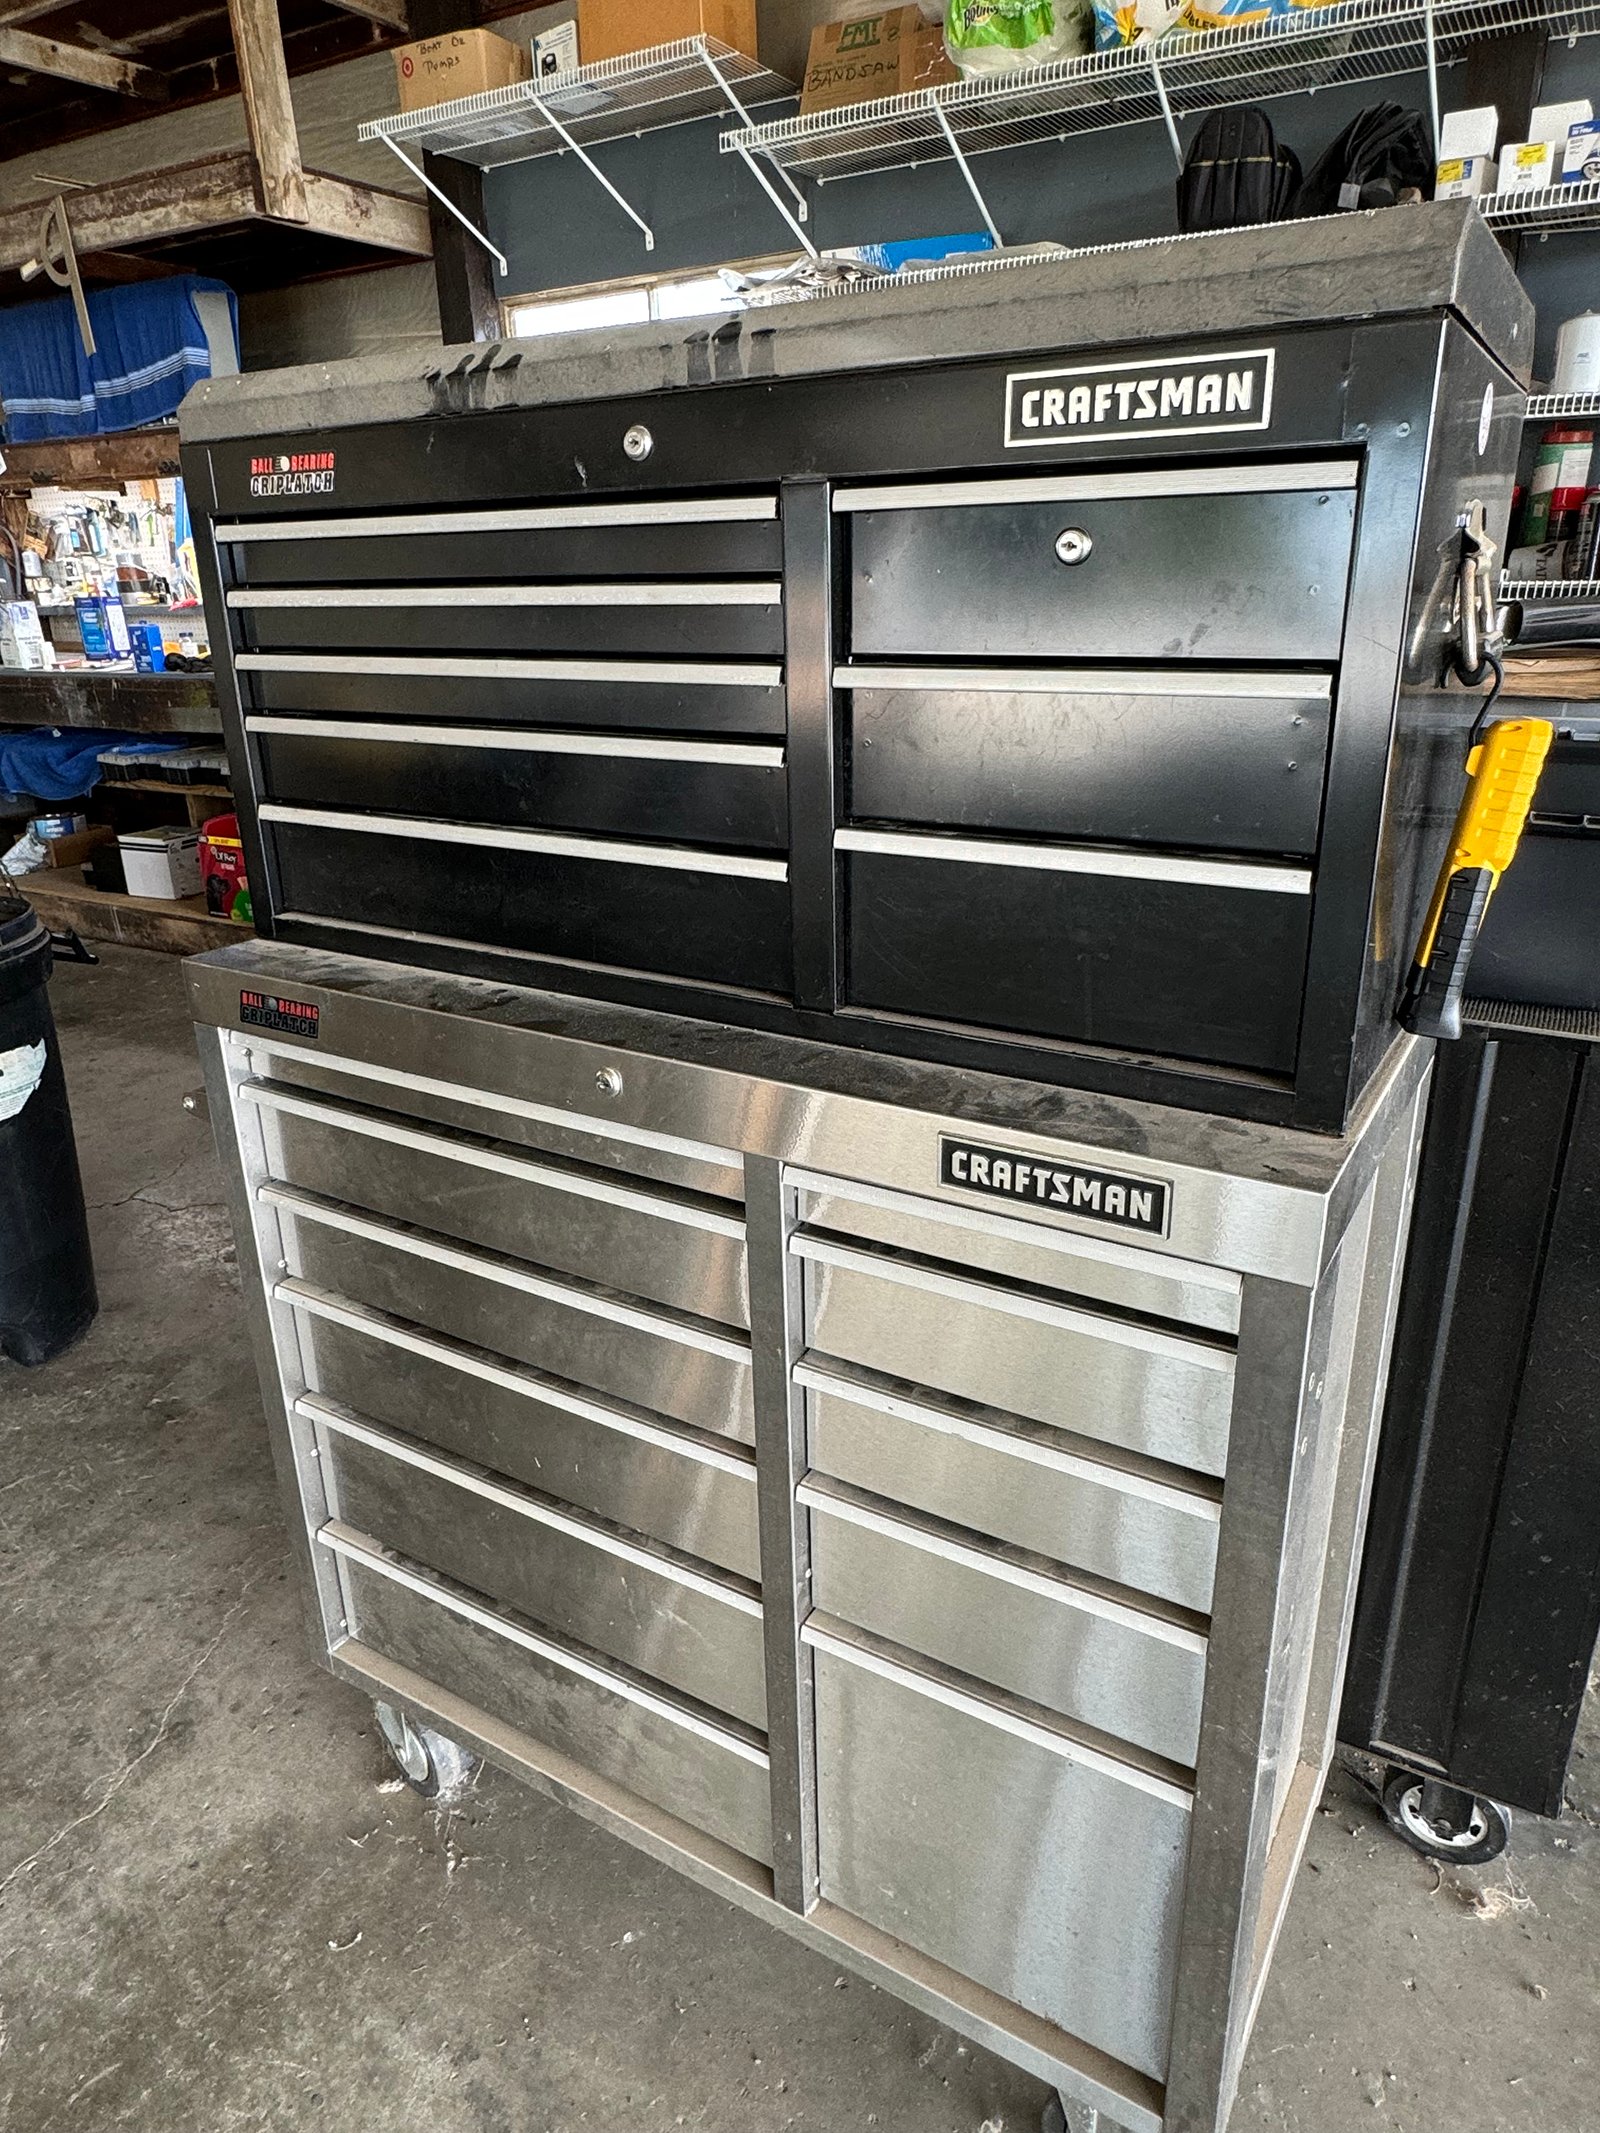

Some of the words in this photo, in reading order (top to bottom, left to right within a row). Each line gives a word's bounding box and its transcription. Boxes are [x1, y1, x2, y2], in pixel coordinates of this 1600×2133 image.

[806, 54, 900, 93] BANDSAW
[1021, 370, 1254, 428] CRAFTSMAN
[251, 457, 274, 475] BALL
[291, 452, 335, 472] BEARING
[251, 471, 335, 497] GRIPLATCH
[241, 1005, 318, 1036] GRIPLATCH
[242, 991, 263, 1008] BALL
[278, 999, 319, 1019] BEARING
[951, 1150, 1153, 1223] CRAFTSMAN
